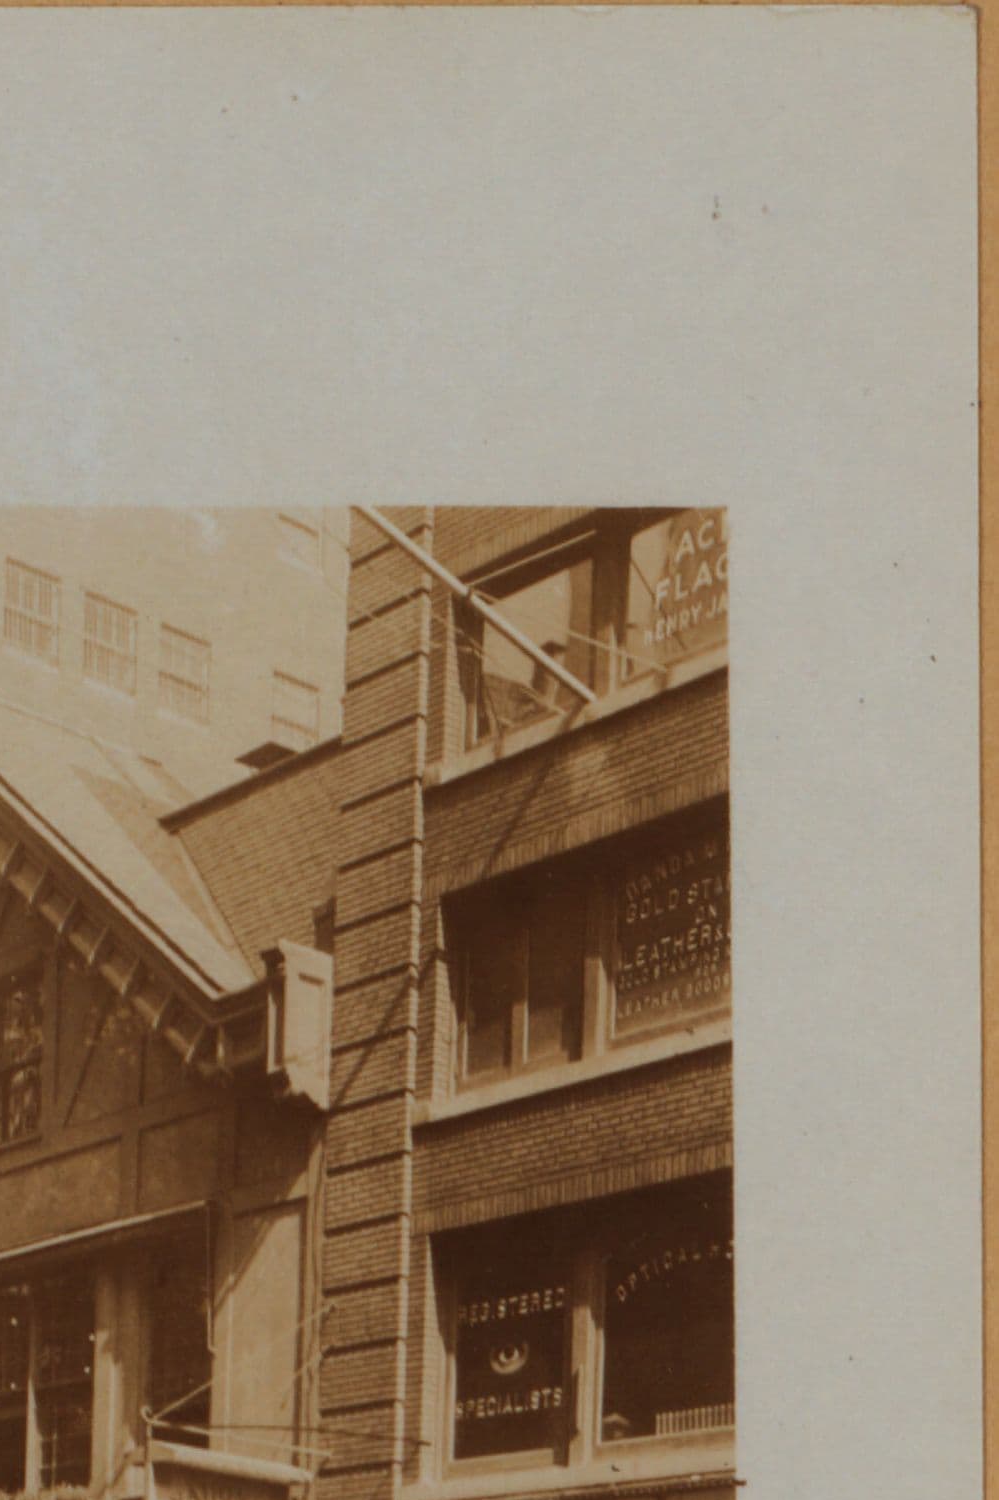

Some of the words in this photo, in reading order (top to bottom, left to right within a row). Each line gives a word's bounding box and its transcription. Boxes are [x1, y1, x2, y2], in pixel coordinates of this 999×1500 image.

[626, 887, 680, 924] GOLD
[622, 923, 712, 971] LEATHER
[458, 1286, 566, 1326] REGISTERED
[456, 1386, 564, 1420] SPECIALISTS
